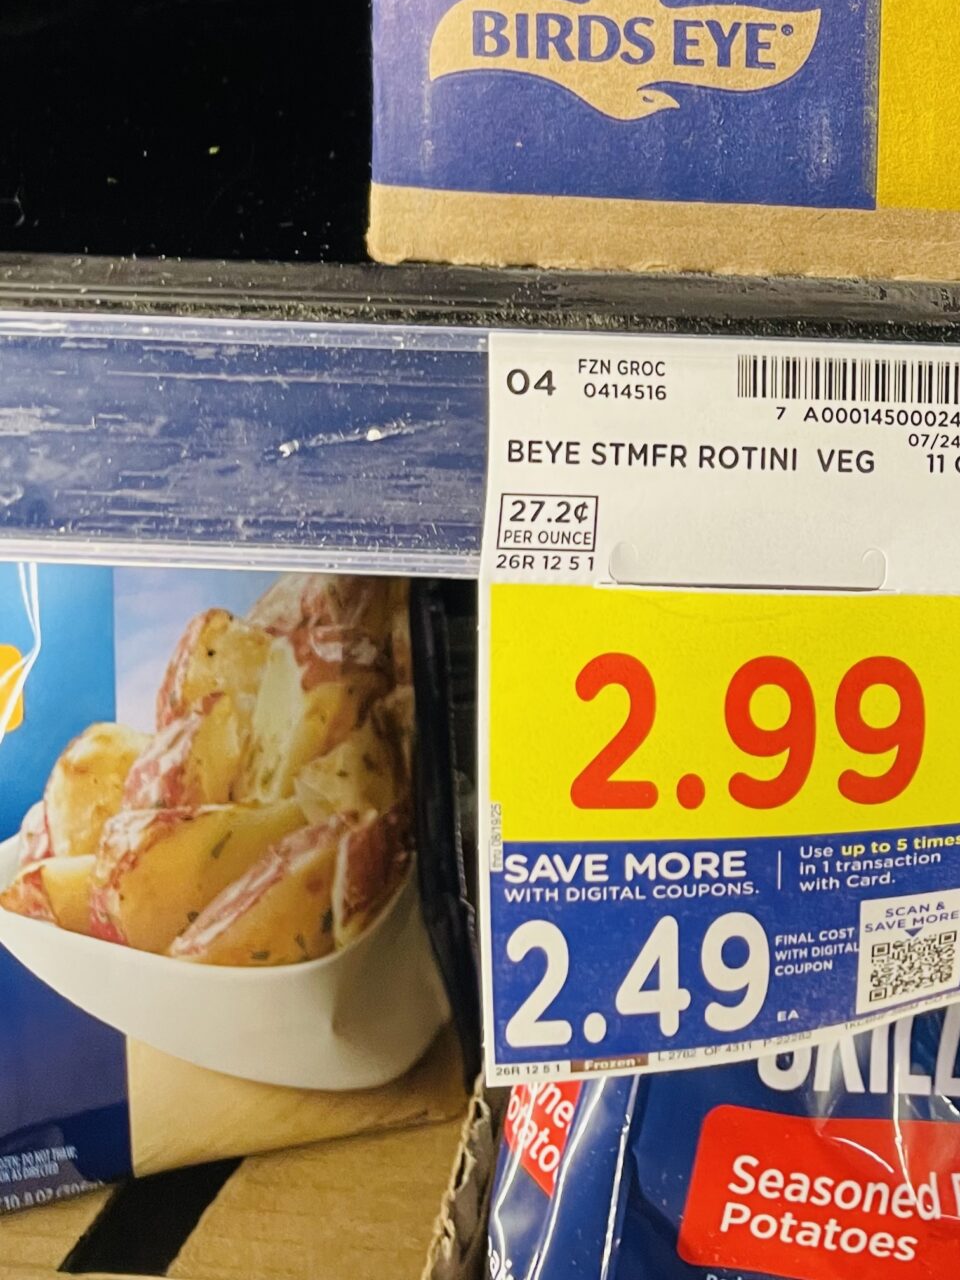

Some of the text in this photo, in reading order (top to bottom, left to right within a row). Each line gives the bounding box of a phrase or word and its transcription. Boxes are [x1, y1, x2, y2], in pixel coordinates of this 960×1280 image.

[471, 10, 777, 69] BIRDS EYE
[506, 359, 666, 396] 04 FZN GROC
[583, 383, 667, 400] 0414516
[776, 407, 786, 420] 7
[507, 439, 875, 473] BEYE STMFR ROTINI VEG
[927, 454, 944, 474] 11
[509, 500, 589, 523] 27.2¢
[503, 530, 592, 545] PER OUNCE
[496, 554, 594, 571] 26R 12 5 1
[569, 652, 926, 810] 2.99
[800, 846, 833, 859] Use
[841, 844, 865, 857] up
[871, 841, 890, 854] to
[897, 838, 908, 851] 5
[504, 850, 747, 883] SAVE MORE
[800, 852, 941, 875] in 1 transaction
[800, 872, 896, 892] with Card.
[504, 882, 759, 903] WITH DIGITAL COUPONS.
[885, 901, 945, 918] SCAN &
[864, 919, 907, 933] SAVE
[775, 927, 855, 946] FINAL COST
[775, 942, 860, 961] WITH DIGITAL
[774, 960, 833, 976] COUPON
[504, 911, 770, 1050] 2.49
[777, 1010, 799, 1022] EA
[584, 1057, 636, 1071] Frozen
[728, 1155, 941, 1220] Seasoned
[720, 1202, 918, 1262] Potatoes
